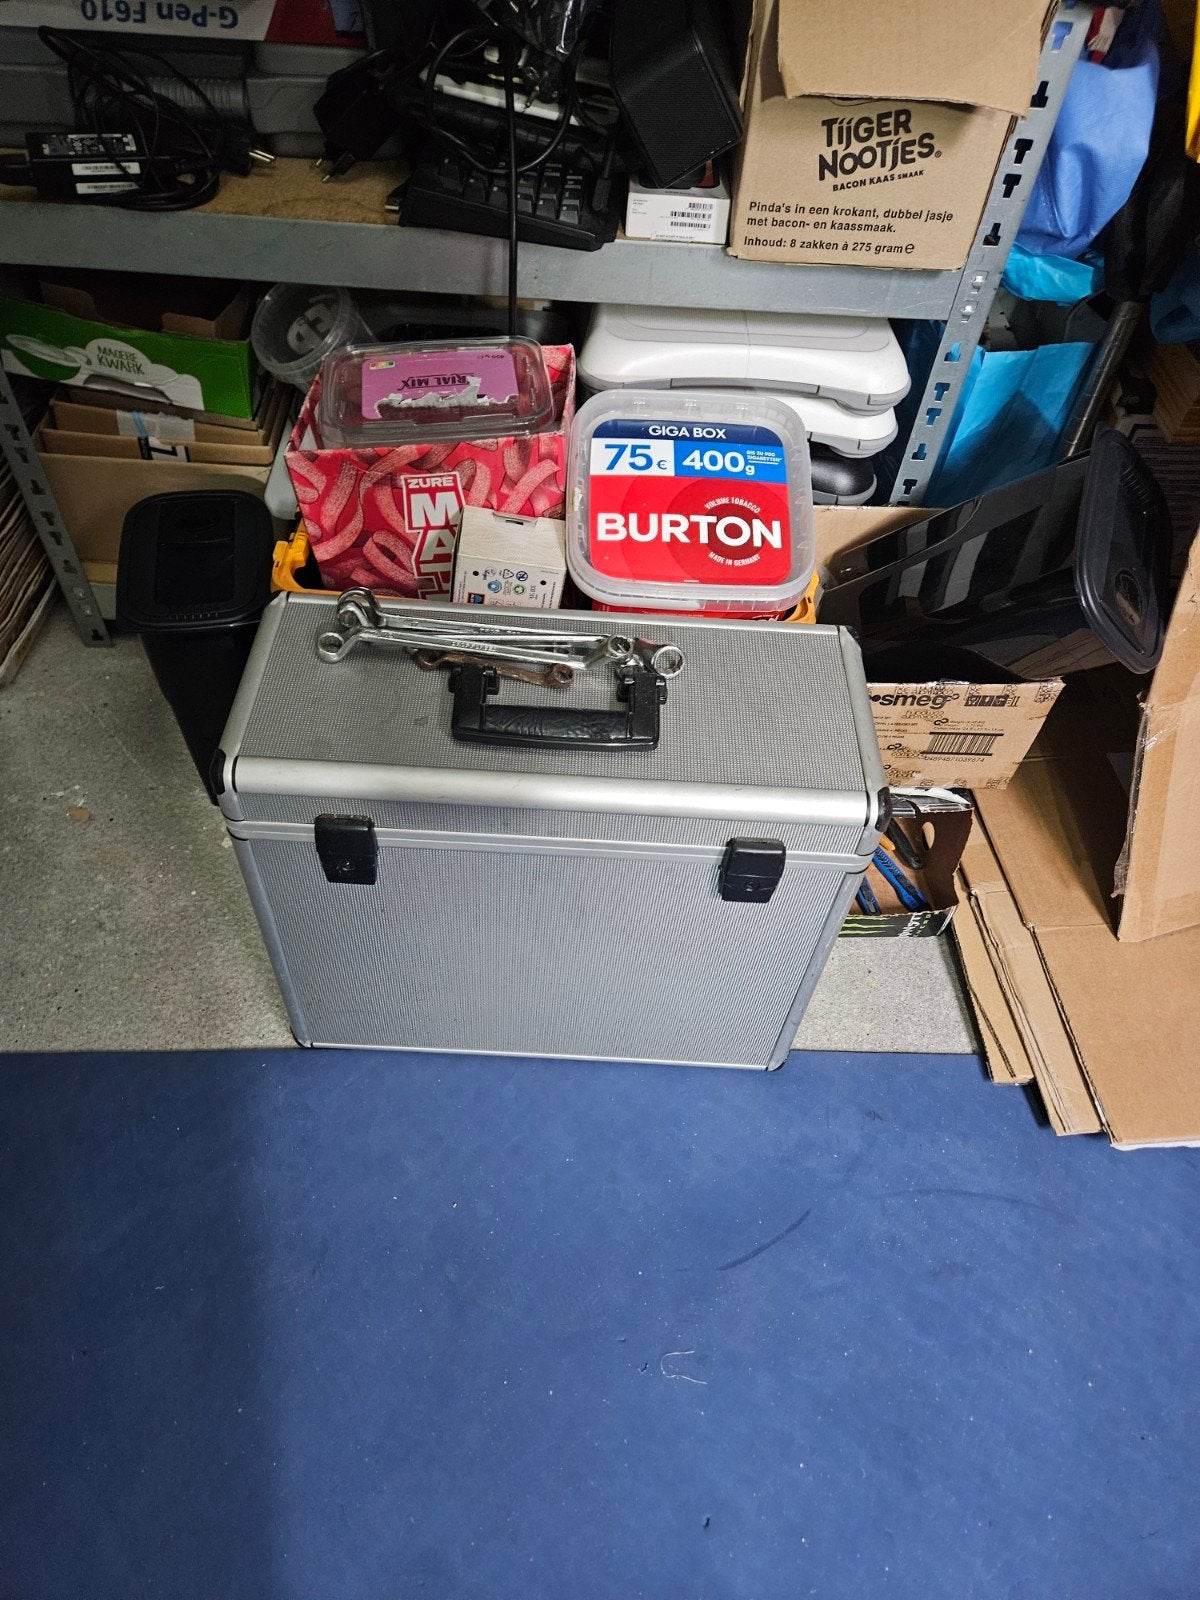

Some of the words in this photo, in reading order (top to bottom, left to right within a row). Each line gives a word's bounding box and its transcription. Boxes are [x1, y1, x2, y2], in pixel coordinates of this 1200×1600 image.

[82, 0, 147, 24] F610
[157, 2, 239, 30] G-Pen
[833, 179, 867, 192] BACON
[869, 174, 895, 186] KAAS
[898, 170, 925, 180] SMAAK
[749, 201, 791, 214] Pinda's
[795, 203, 806, 215] in
[809, 206, 830, 216] een
[833, 205, 879, 219] krokant,
[883, 208, 923, 220] dubbel
[924, 210, 954, 223] jasje
[747, 217, 768, 227] met
[771, 217, 811, 228] bacon-
[813, 221, 827, 230] en
[830, 220, 897, 233] kaassmaak.
[744, 235, 787, 248] Inhoud:
[789, 238, 797, 248] 8
[800, 238, 839, 251] zakken
[841, 240, 849, 251] à
[852, 241, 872, 252] 275
[96, 354, 145, 375] KWARK
[398, 377, 430, 391] MIX
[434, 373, 469, 386] RIAL
[648, 425, 690, 437] GIGA
[693, 427, 727, 439] BOX
[407, 476, 455, 489] ZURE
[704, 496, 730, 510] VOLUME
[731, 497, 761, 514] TOBACCO
[597, 512, 783, 549] BURTON
[708, 551, 726, 564] MADE
[725, 558, 733, 566] IN
[733, 553, 761, 567] GERMANY
[879, 693, 948, 710] smeg
